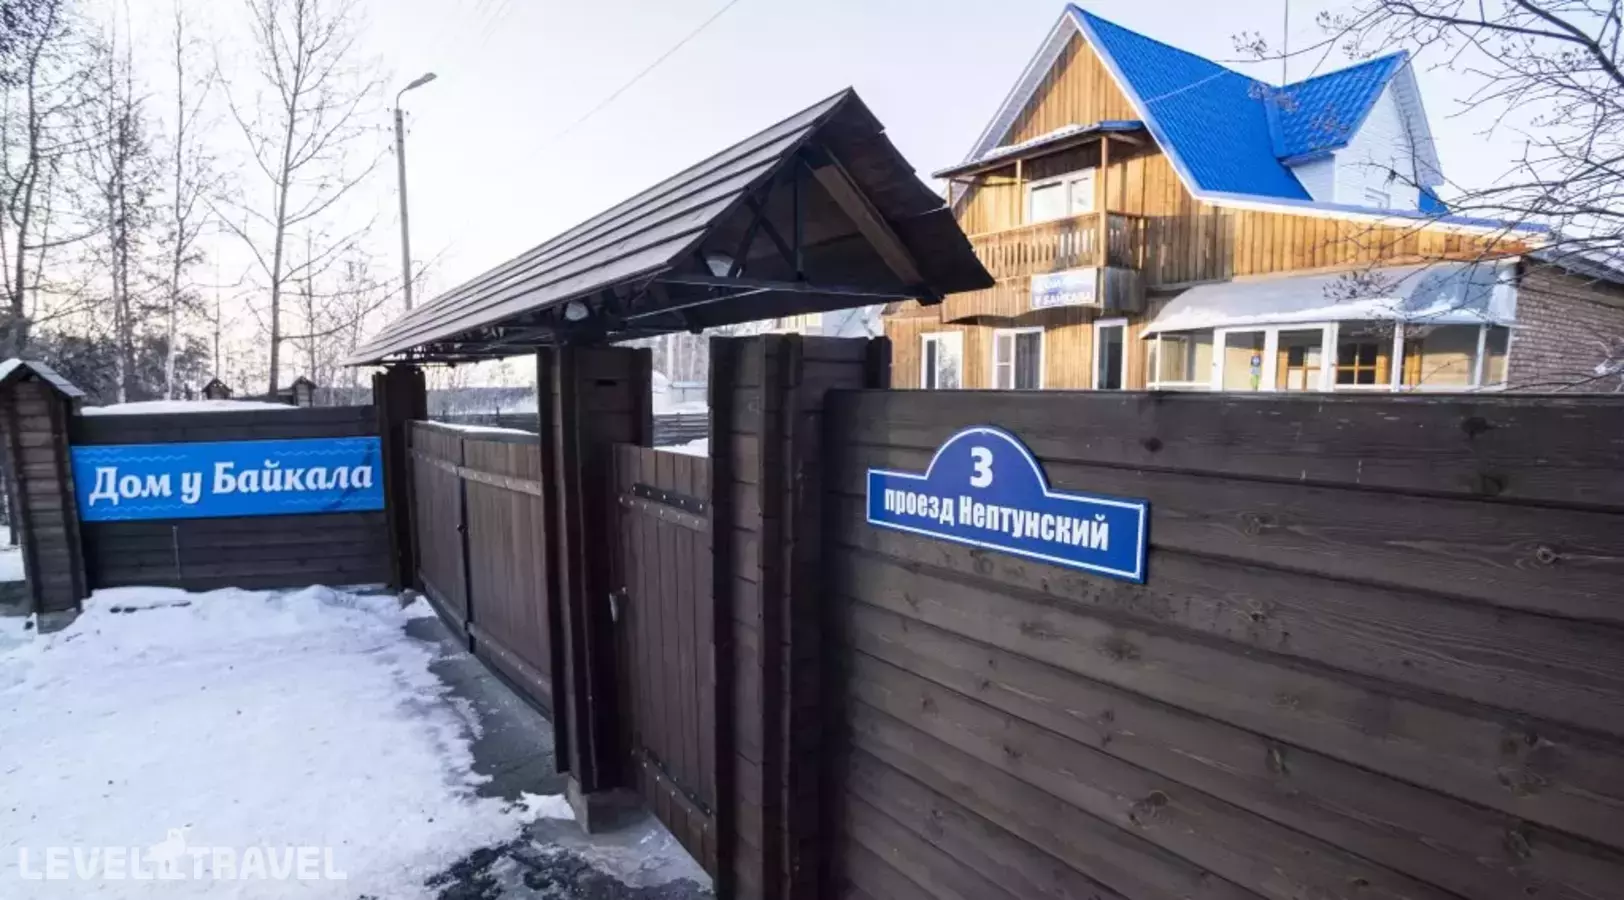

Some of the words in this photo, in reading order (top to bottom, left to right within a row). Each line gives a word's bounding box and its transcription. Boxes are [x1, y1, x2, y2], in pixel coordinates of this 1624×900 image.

[88, 466, 171, 507] Дом
[180, 472, 202, 504] у
[212, 459, 373, 495] Байкала
[969, 446, 994, 488] 3
[884, 487, 954, 527] проезд
[958, 495, 1109, 551] Нептунский
